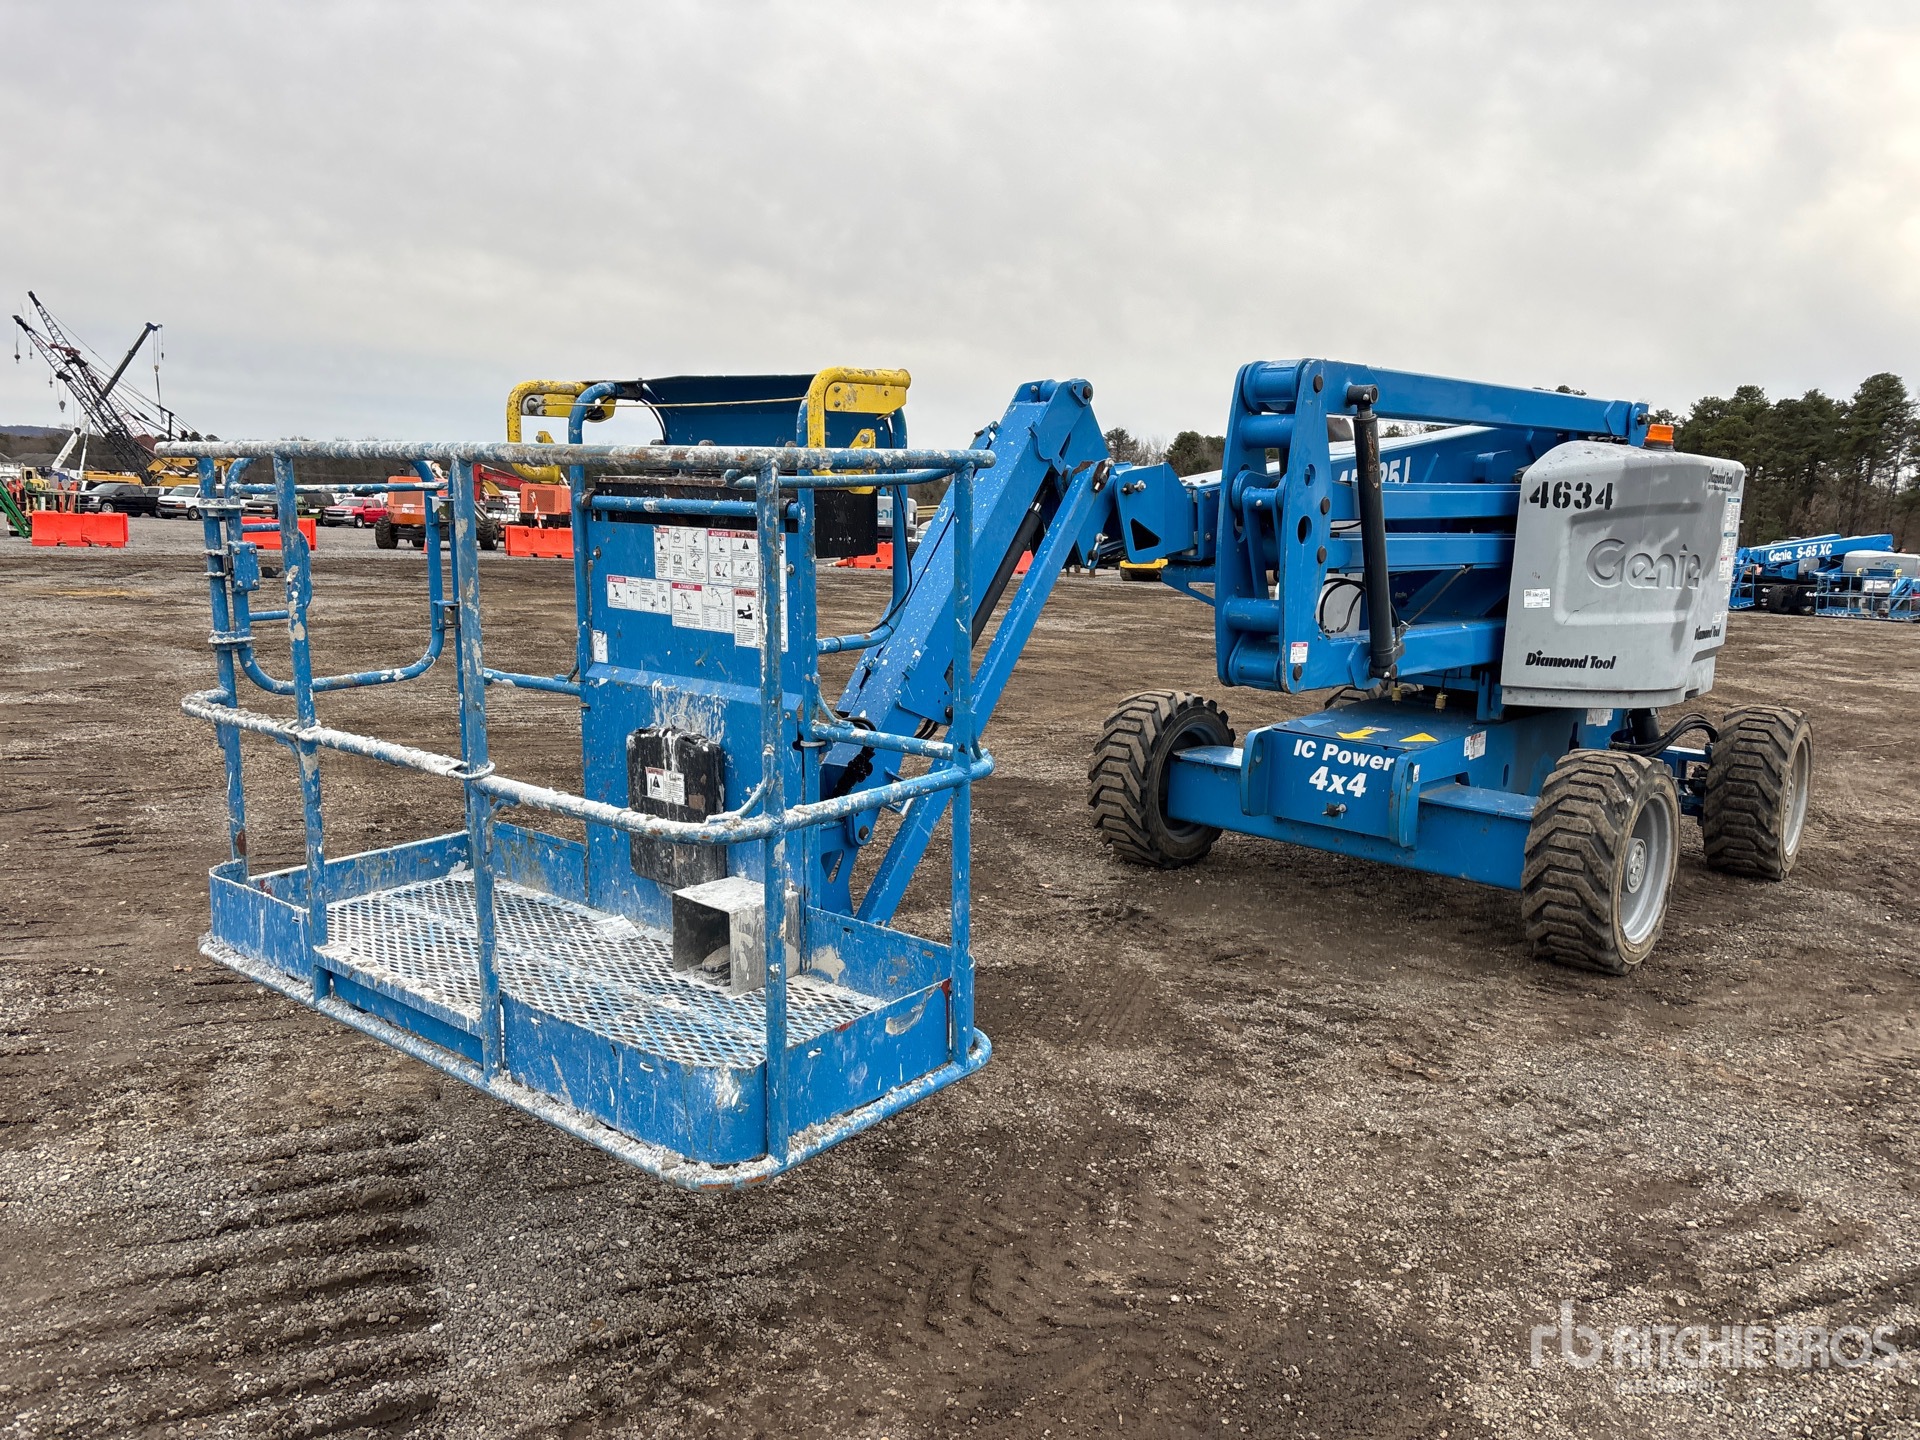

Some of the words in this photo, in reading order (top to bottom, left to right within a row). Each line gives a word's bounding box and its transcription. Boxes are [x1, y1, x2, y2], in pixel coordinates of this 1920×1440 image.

[1529, 481, 1614, 511] 4634
[1586, 538, 1702, 590] Genie
[1768, 548, 1792, 562] Genie
[1796, 544, 1817, 559] S-65
[1819, 543, 1832, 556] XC
[1525, 650, 1589, 669] Diamond
[1590, 655, 1617, 670] Tool
[1293, 739, 1317, 759] IC
[1322, 743, 1396, 772] Power
[1309, 766, 1367, 798] 4x4
